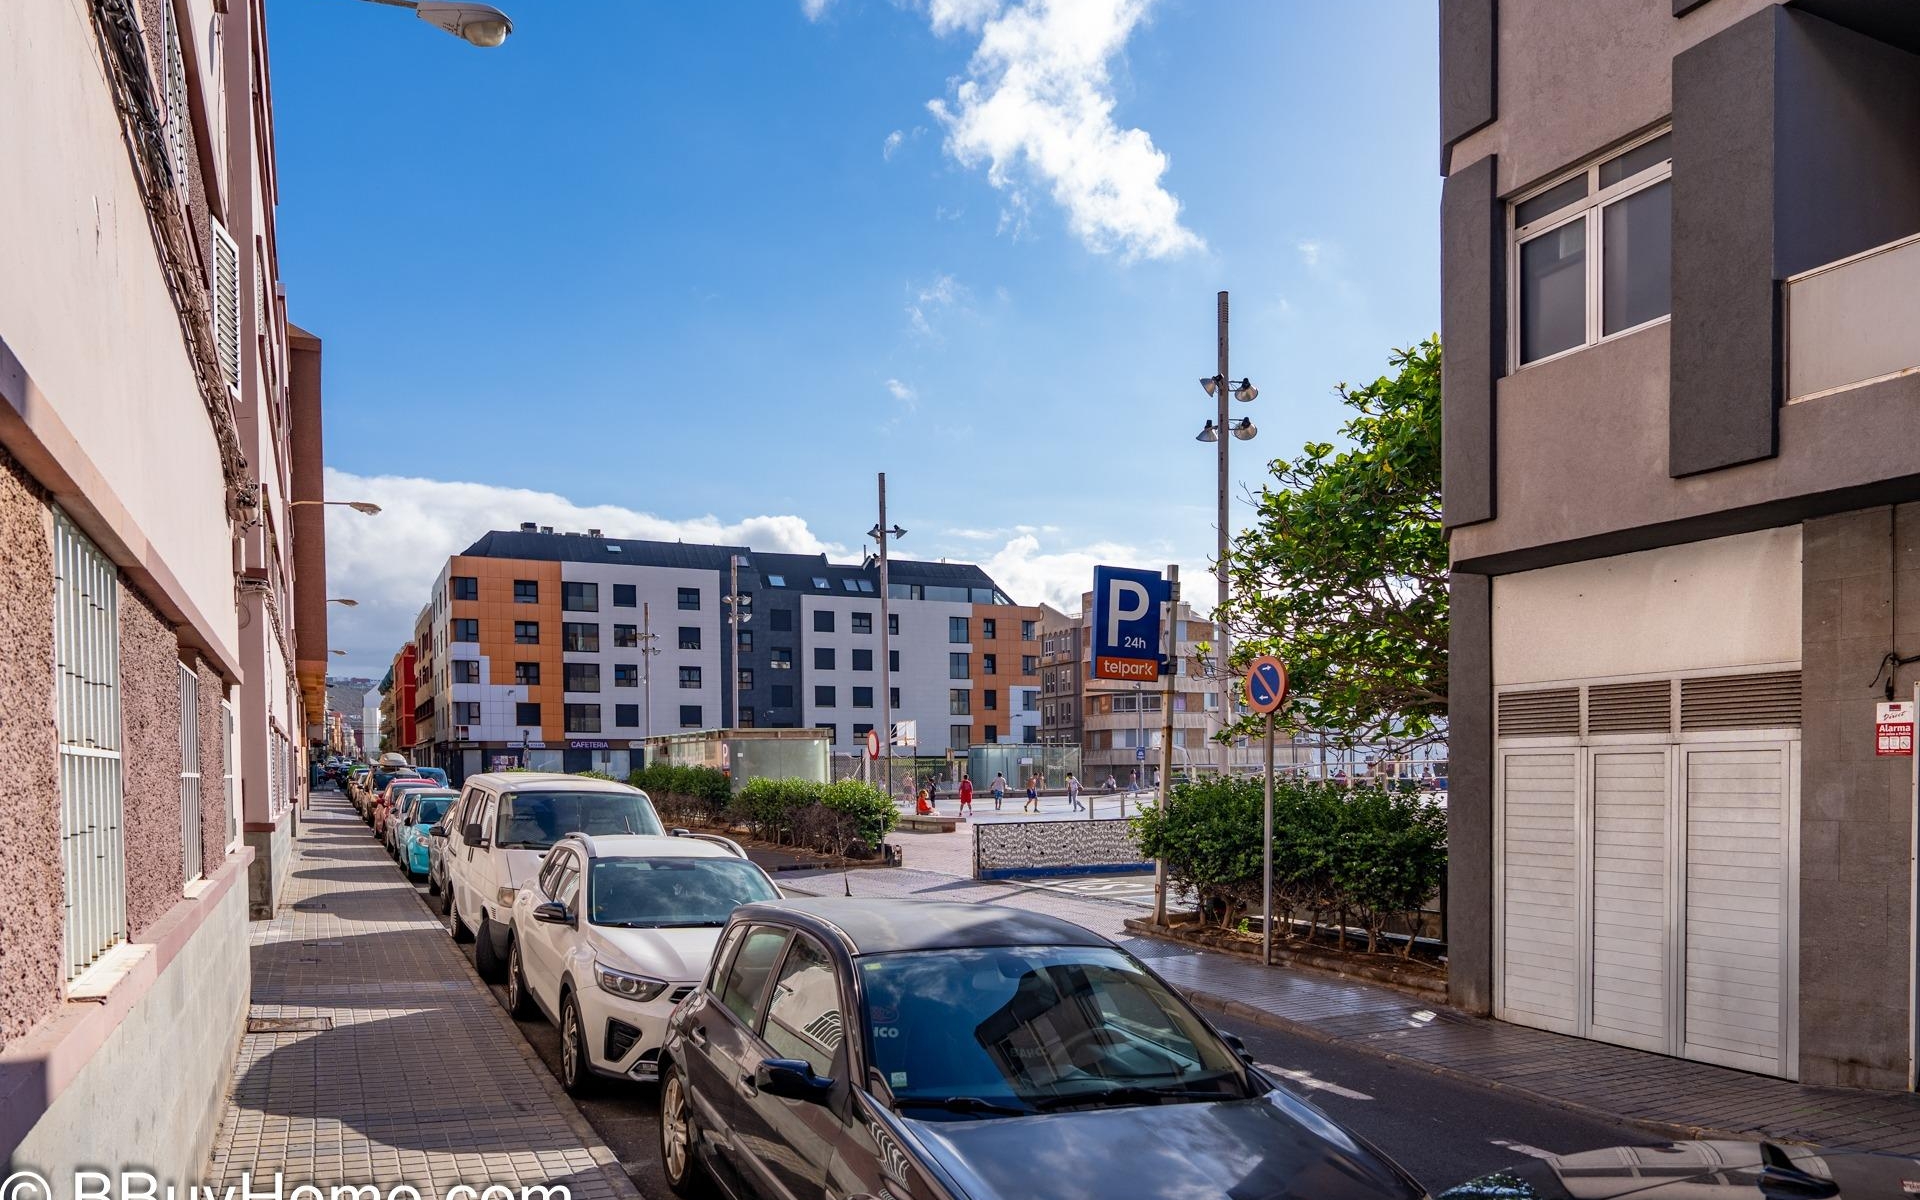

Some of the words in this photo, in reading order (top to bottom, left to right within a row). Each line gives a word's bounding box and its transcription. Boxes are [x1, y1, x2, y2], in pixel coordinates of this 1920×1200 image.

[1107, 578, 1150, 647] P
[1124, 636, 1146, 649] 24h
[1104, 660, 1153, 677] telpark
